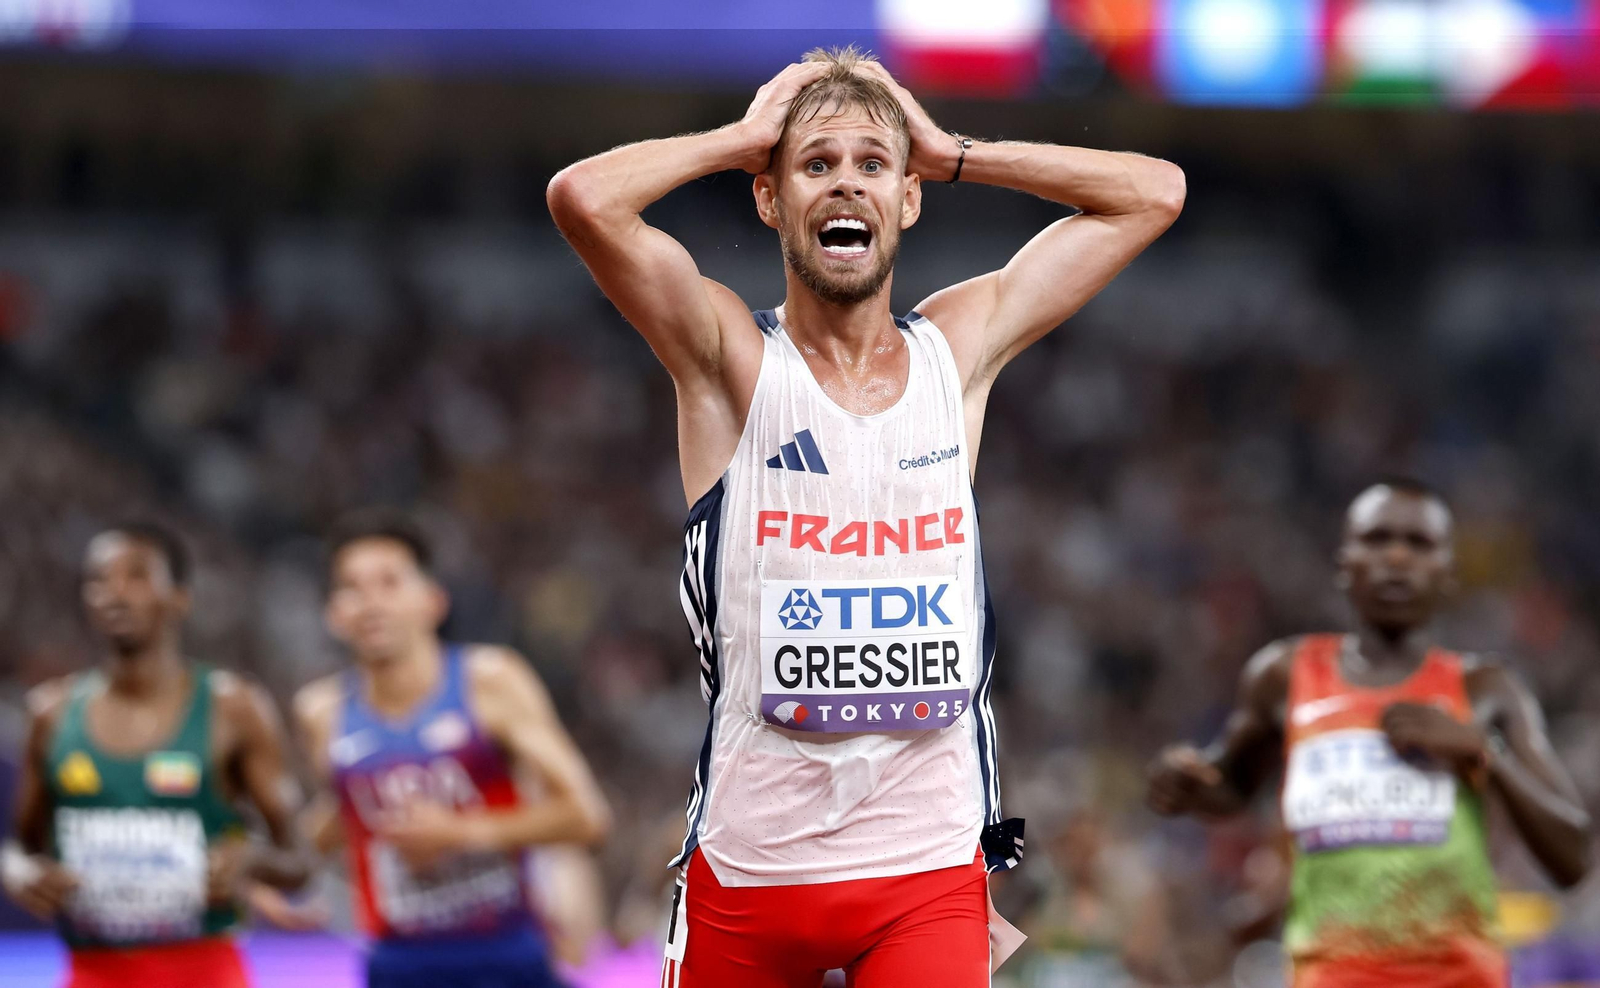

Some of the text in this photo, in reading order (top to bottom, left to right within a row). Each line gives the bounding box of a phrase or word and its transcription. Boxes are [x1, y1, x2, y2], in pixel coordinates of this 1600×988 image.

[899, 455, 931, 470] Crédit
[757, 507, 965, 557] FRANCE
[822, 584, 953, 630] TDK
[774, 641, 962, 689] GRESSIER
